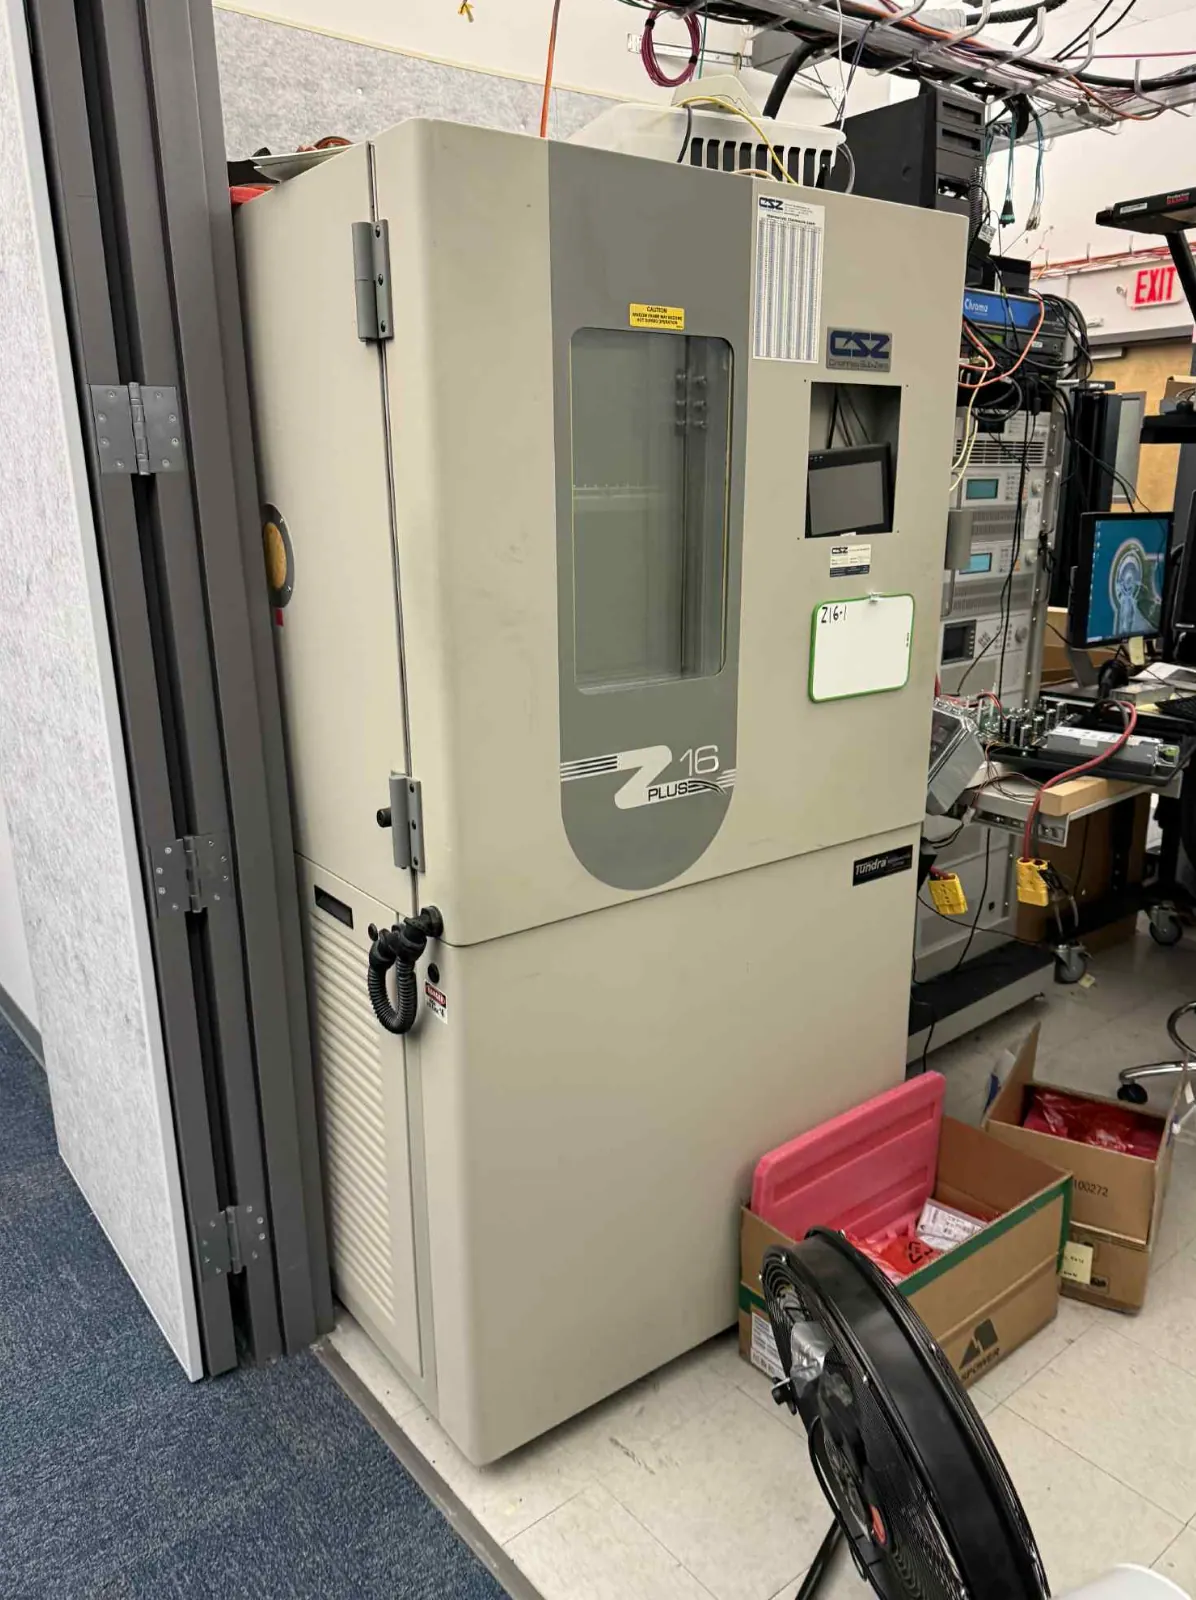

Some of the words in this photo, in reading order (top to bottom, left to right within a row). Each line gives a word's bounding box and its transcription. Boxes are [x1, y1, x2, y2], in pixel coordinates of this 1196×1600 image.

[759, 197, 783, 210] CSZ
[1135, 266, 1176, 304] EXIT
[646, 305, 667, 313] CAUTION
[830, 330, 890, 359] CSZ
[679, 744, 719, 776] 16
[648, 781, 689, 802] PLUS
